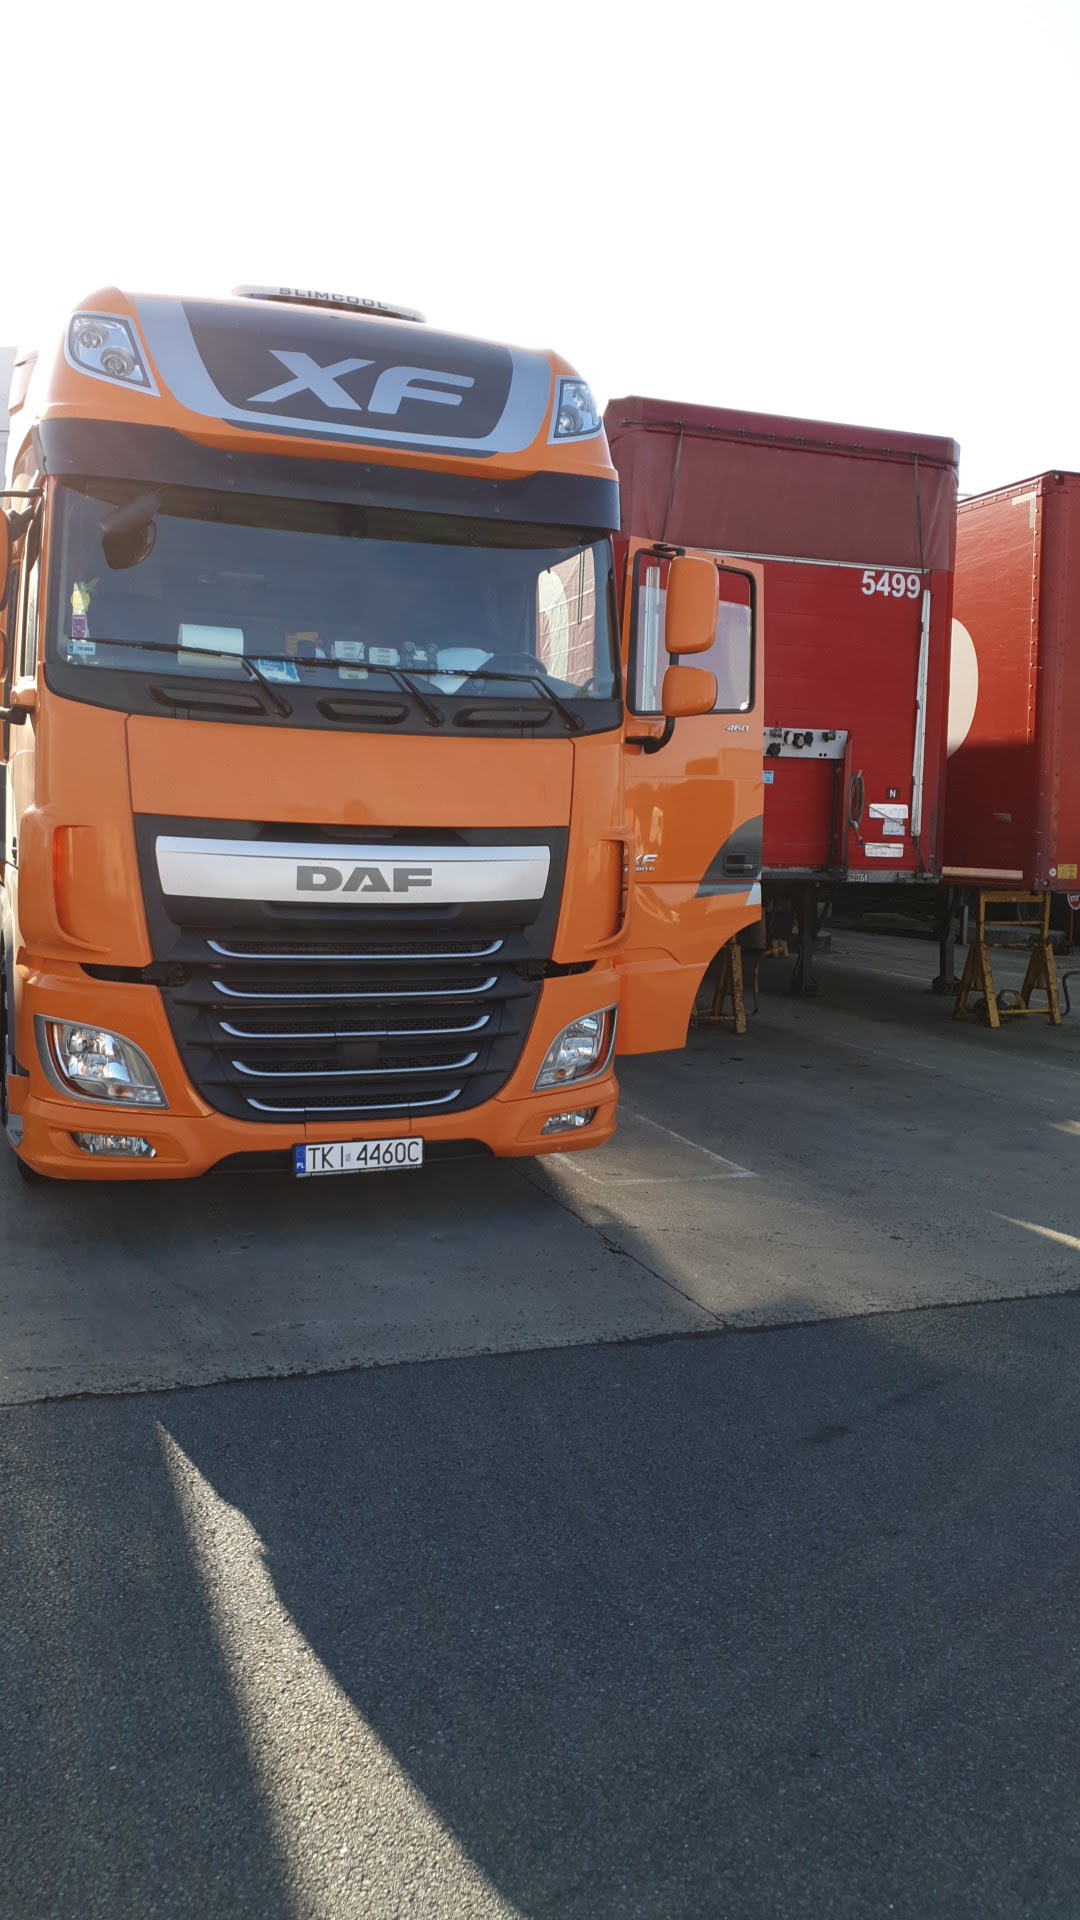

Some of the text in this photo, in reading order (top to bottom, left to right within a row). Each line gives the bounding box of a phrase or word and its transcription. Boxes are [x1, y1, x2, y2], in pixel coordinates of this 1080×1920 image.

[278, 287, 389, 310] SLIMCOOL
[246, 349, 475, 415] XF
[861, 570, 921, 599] 5499
[726, 724, 749, 733] 460
[889, 789, 897, 798] N
[296, 865, 433, 893] DAF
